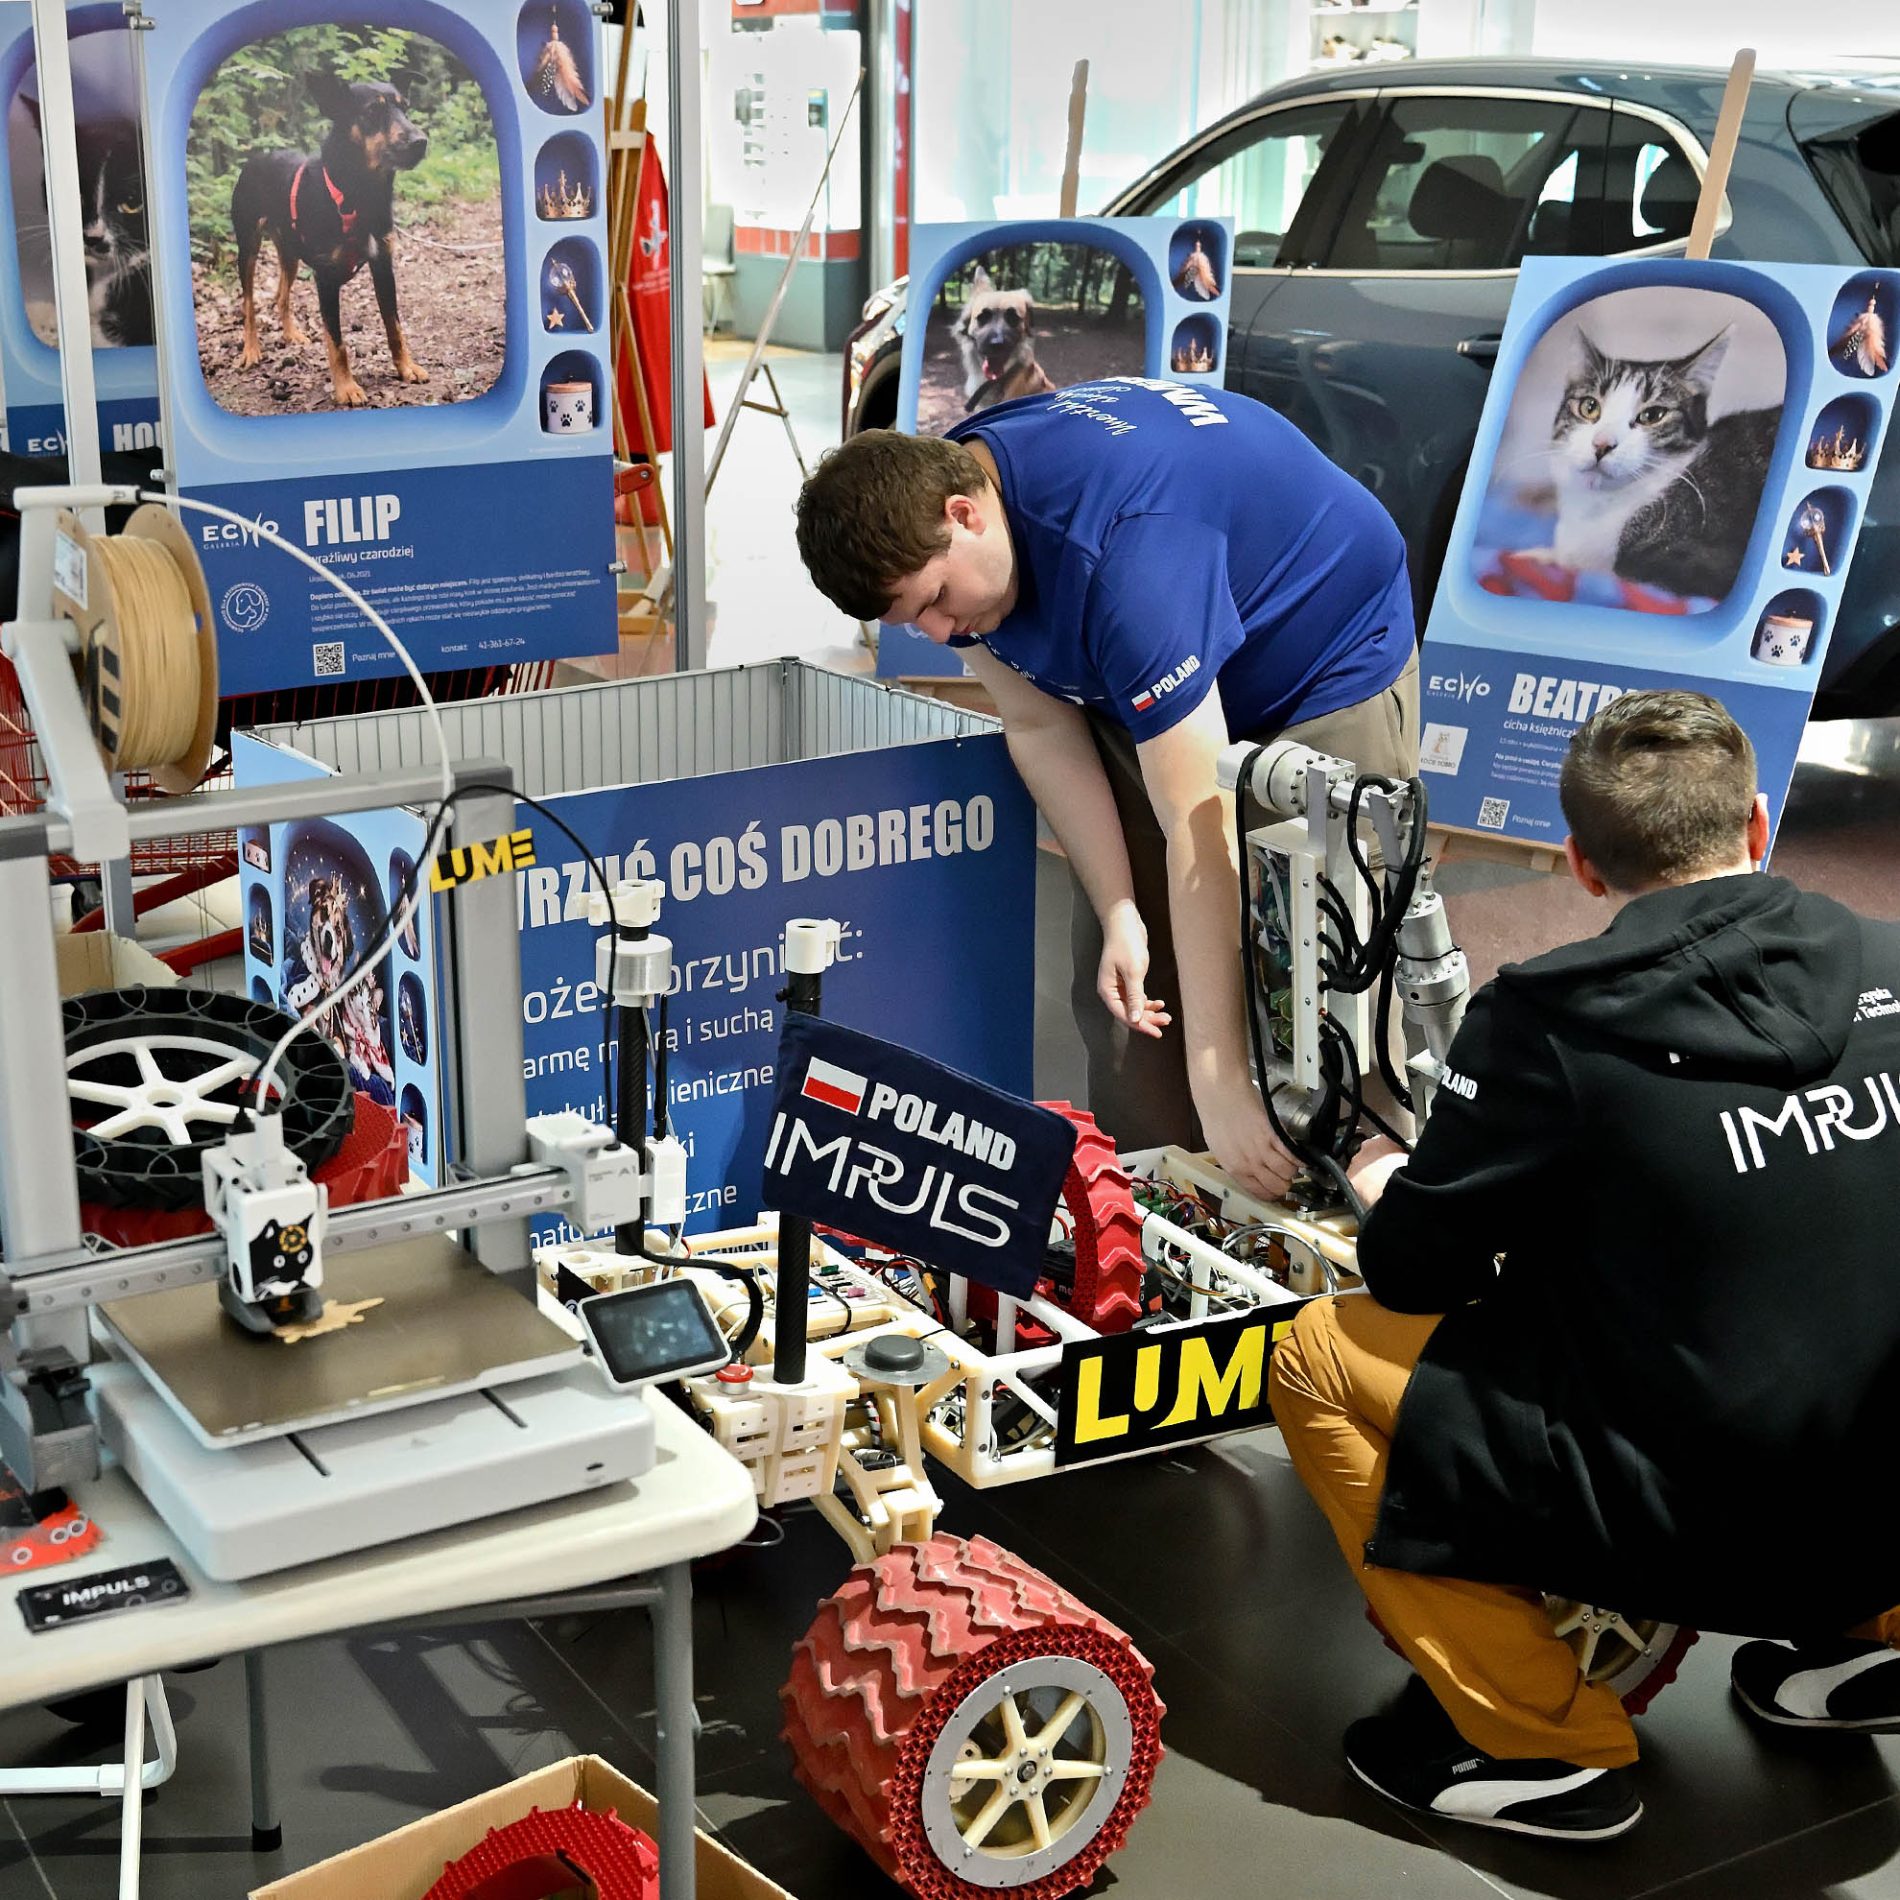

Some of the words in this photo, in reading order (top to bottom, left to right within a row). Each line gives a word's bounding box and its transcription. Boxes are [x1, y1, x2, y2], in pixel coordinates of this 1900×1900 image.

[304, 494, 401, 547] FILIP
[309, 551, 358, 565] wrażliwy
[360, 545, 414, 562] czarodziej
[1151, 655, 1200, 699] POLAND
[1429, 670, 1491, 704] ECHO
[1507, 672, 1637, 723] BEATR
[1503, 719, 1528, 732] cicha
[1529, 722, 1578, 739] księżniczk
[430, 827, 536, 893] LUME
[671, 820, 768, 901] COŚ
[781, 795, 995, 883] DOBREGO
[523, 1046, 590, 1080] armę
[686, 1018, 691, 1044] i
[700, 1007, 774, 1042] suchą
[867, 1082, 1017, 1171] POLAND
[1719, 1072, 1900, 1173] IMPUL
[763, 1112, 1019, 1248] IMPULS
[1074, 1319, 1294, 1444] LUM
[62, 1575, 151, 1606] IMPULS
[1452, 1759, 1477, 1775] PUMA
